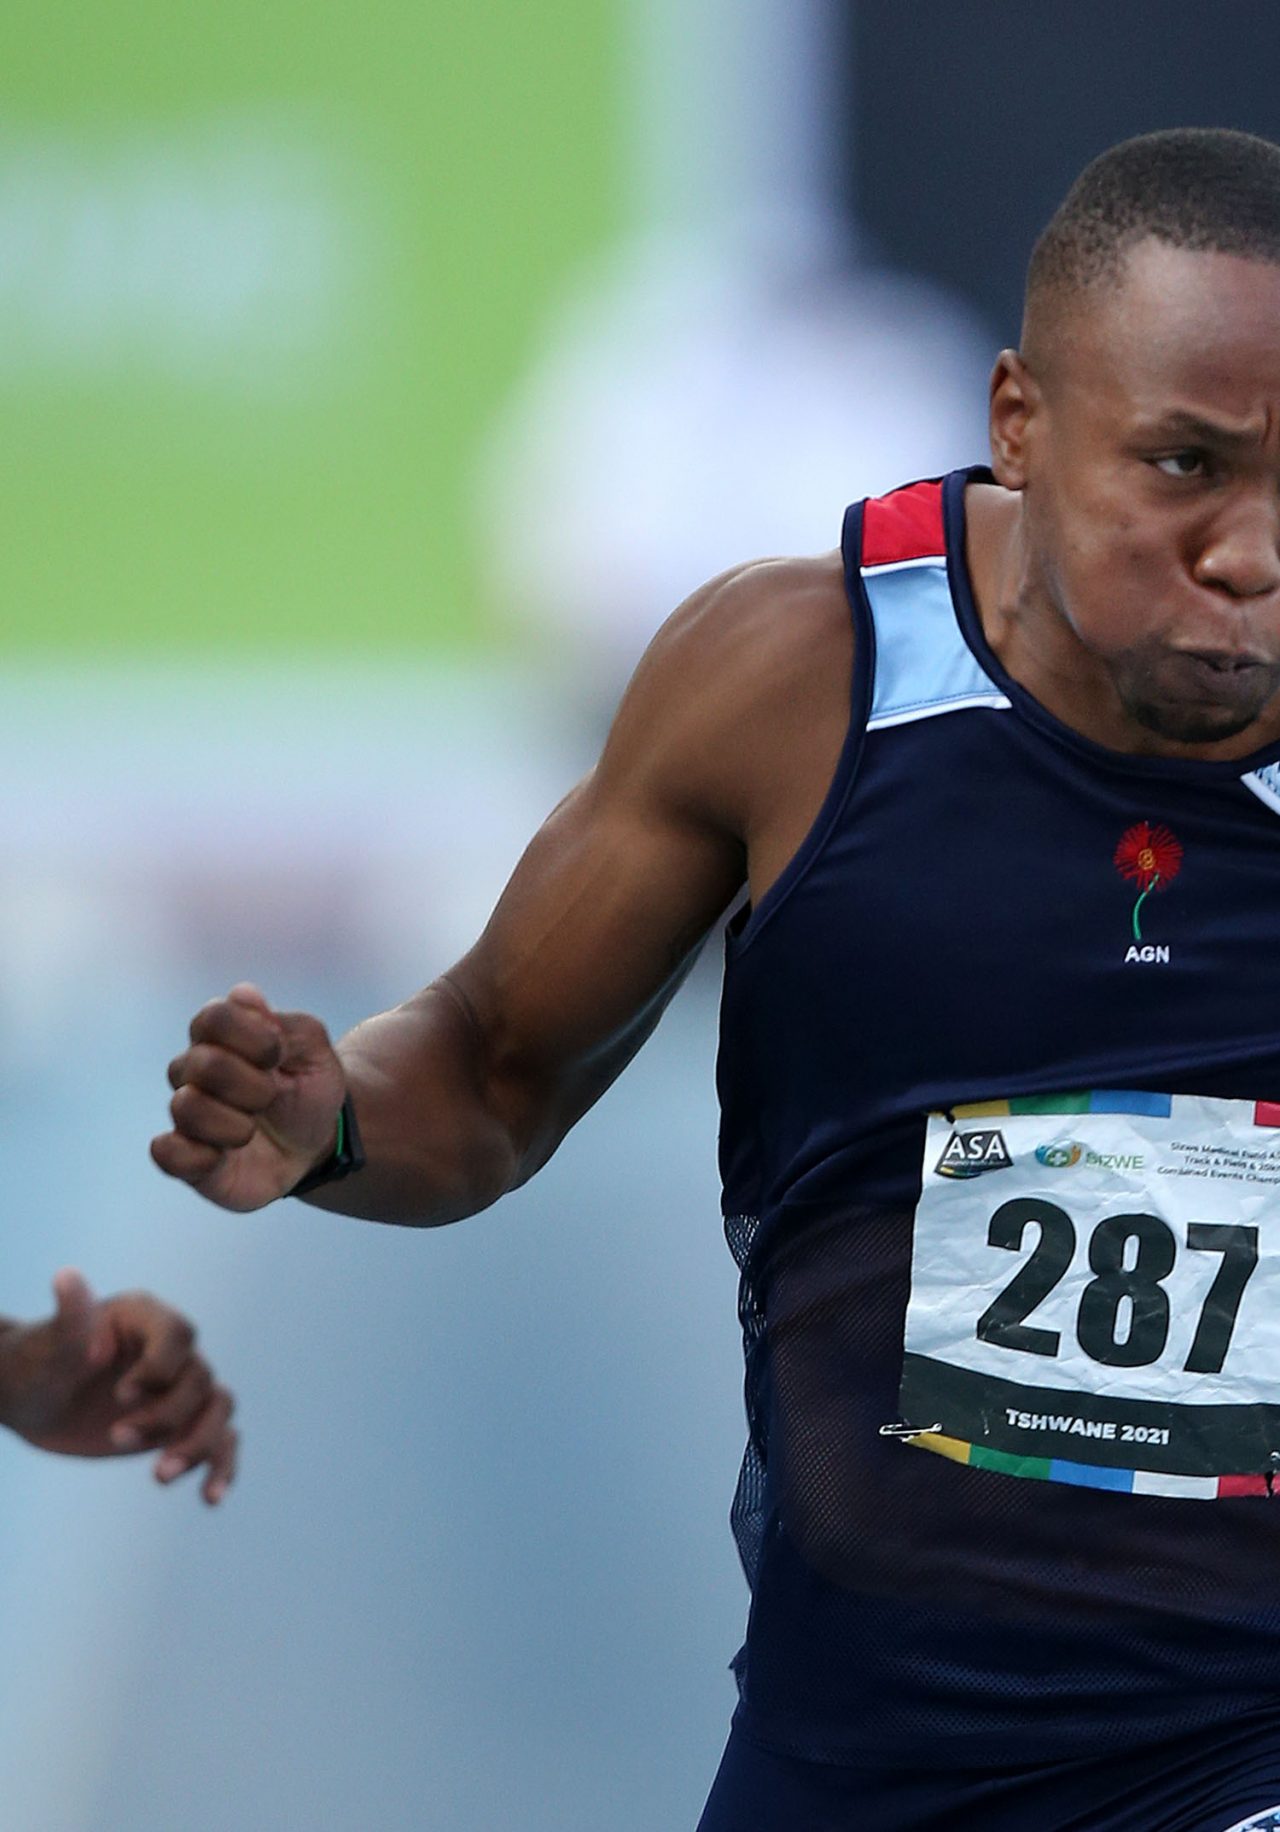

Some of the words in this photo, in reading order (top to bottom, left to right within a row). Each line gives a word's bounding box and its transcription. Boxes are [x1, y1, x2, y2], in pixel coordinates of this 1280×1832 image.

[1124, 945, 1170, 963] AGN
[945, 1134, 1005, 1160] ASA
[1184, 1155, 1211, 1165] Track
[1157, 1166, 1208, 1179] Combined
[1210, 1170, 1244, 1181] Events
[976, 1197, 1260, 1374] 287
[1005, 1408, 1117, 1440] TSHWANE
[1120, 1425, 1171, 1445] 2021
